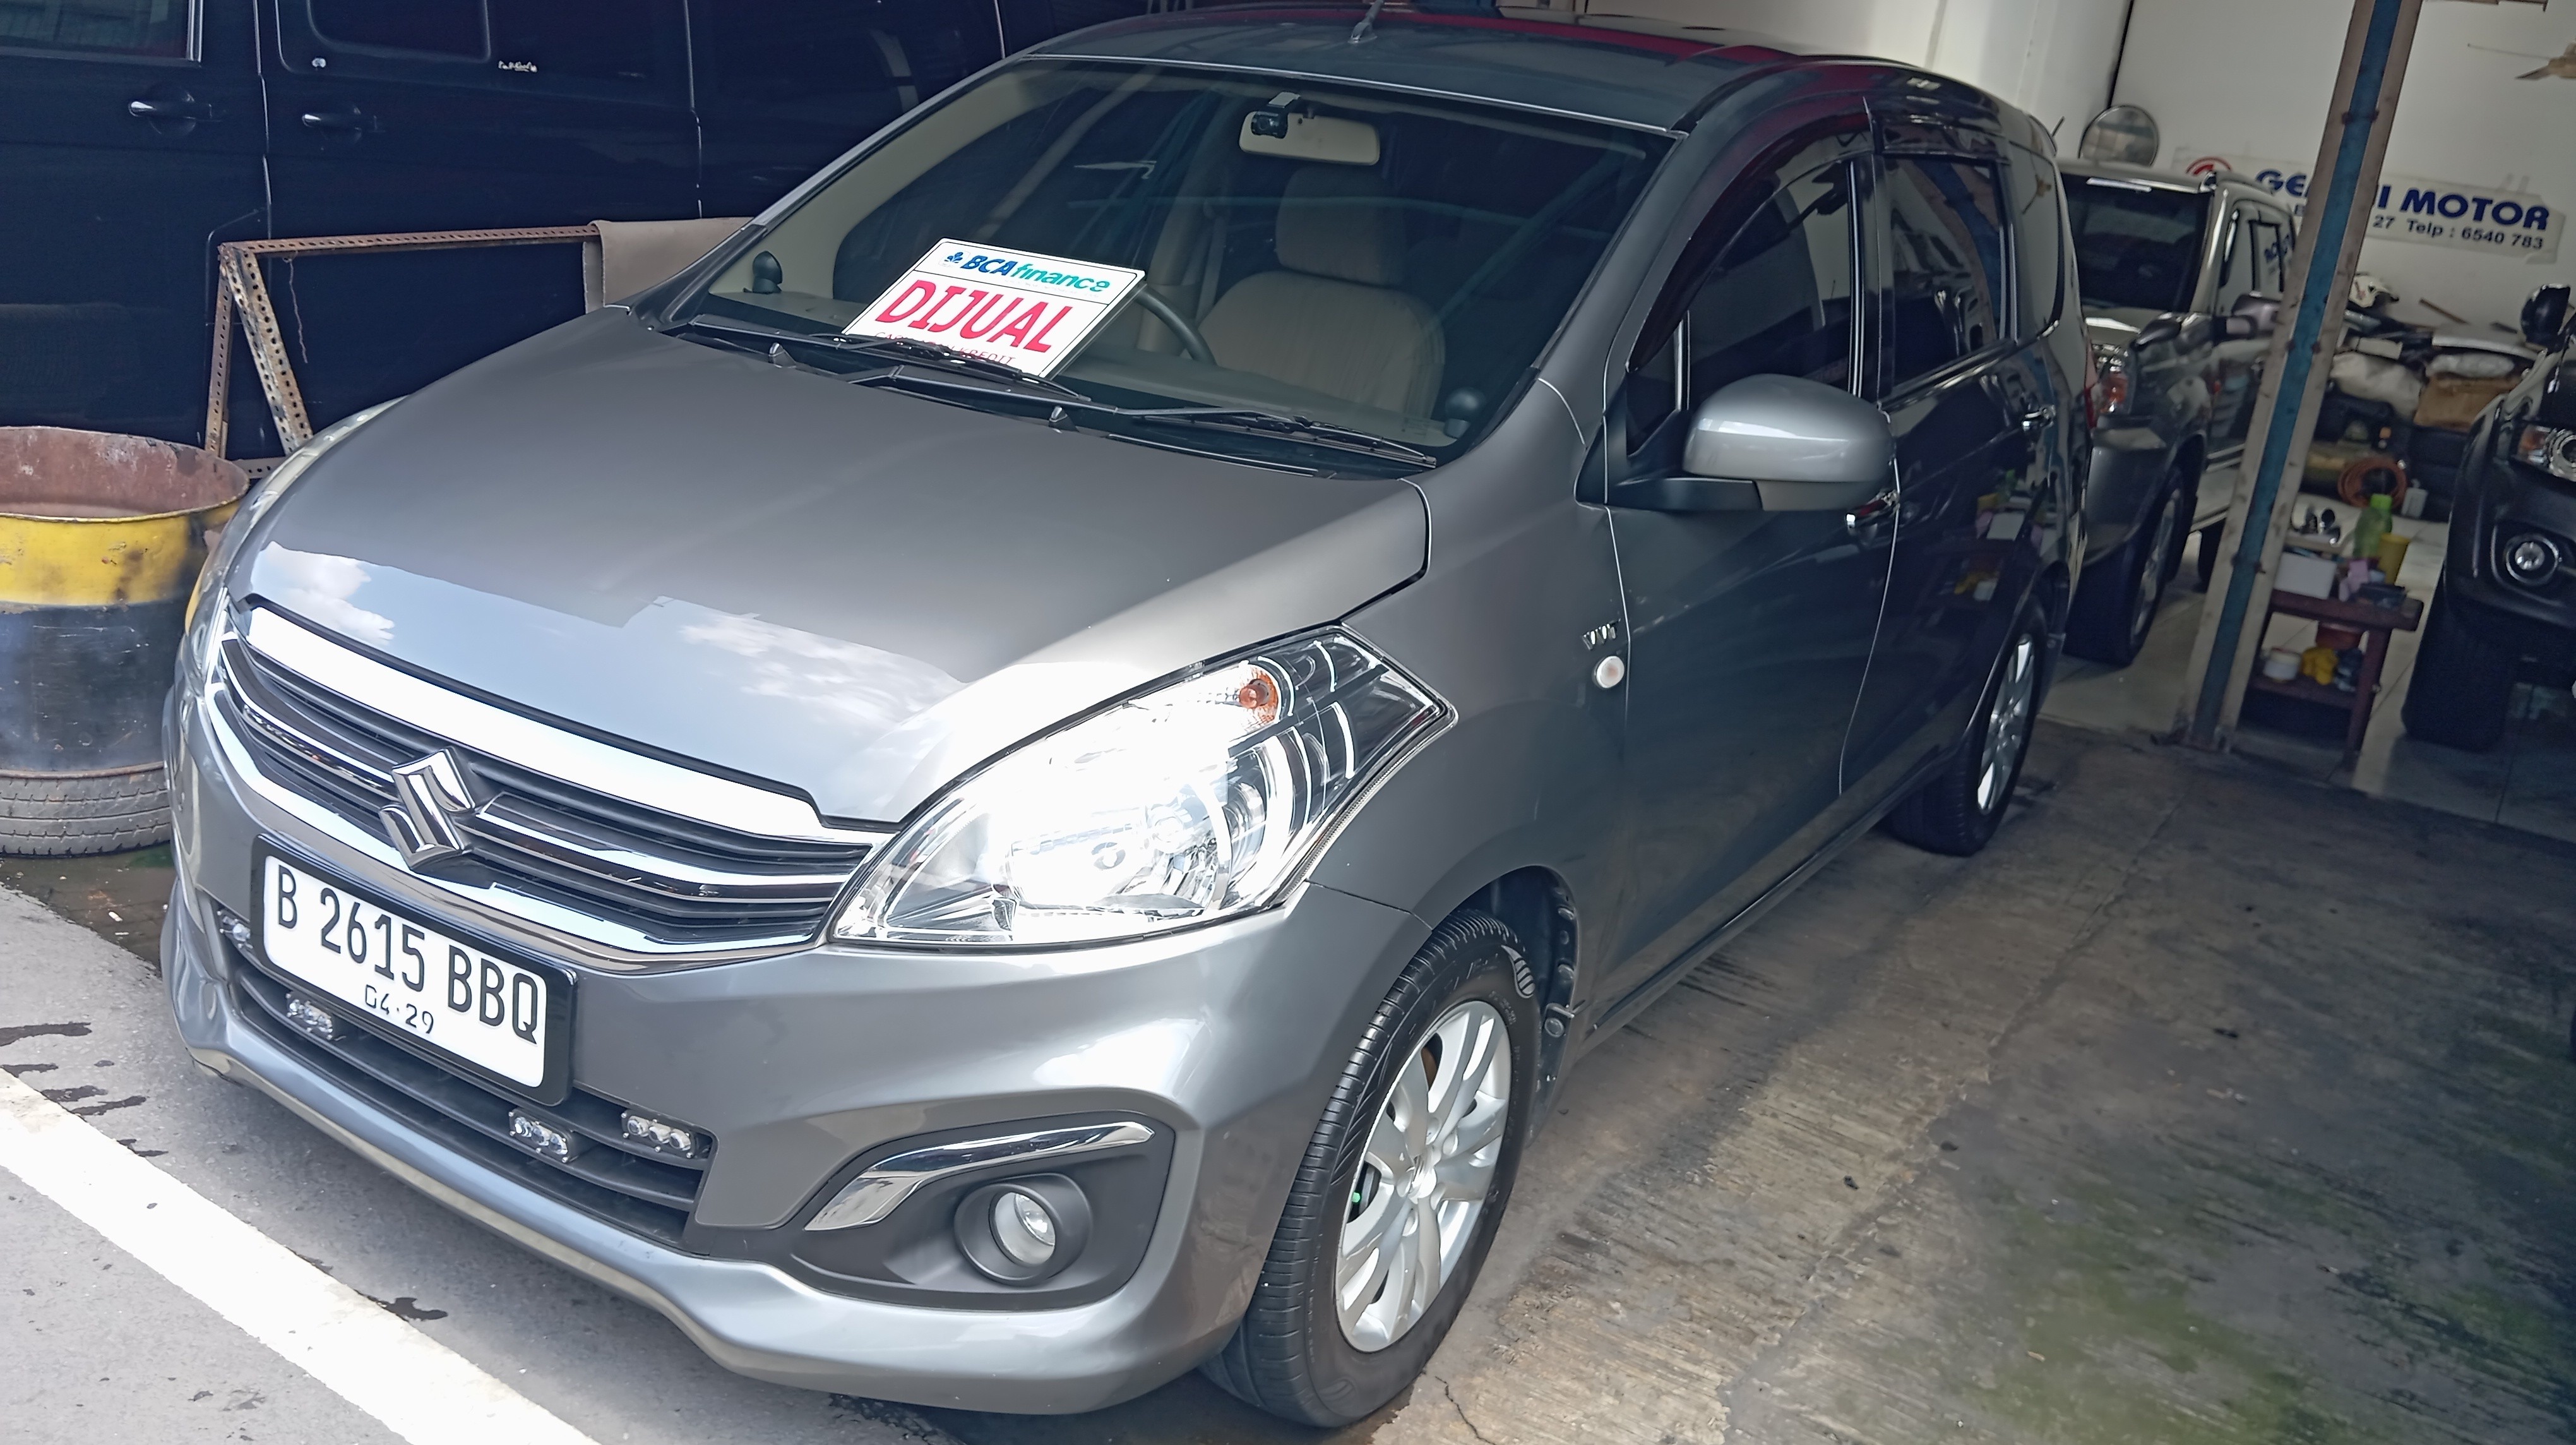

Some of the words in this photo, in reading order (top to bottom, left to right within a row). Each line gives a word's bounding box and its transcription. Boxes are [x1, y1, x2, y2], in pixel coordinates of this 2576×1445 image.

[2400, 189, 2549, 231] MOTOR
[2407, 219, 2443, 237] Telp
[2462, 227, 2505, 243] 6540
[2512, 234, 2543, 249] 783
[875, 280, 1073, 353] DIJUAL
[278, 865, 297, 929] B
[320, 888, 424, 992] 2615
[448, 945, 537, 1045] BBQ
